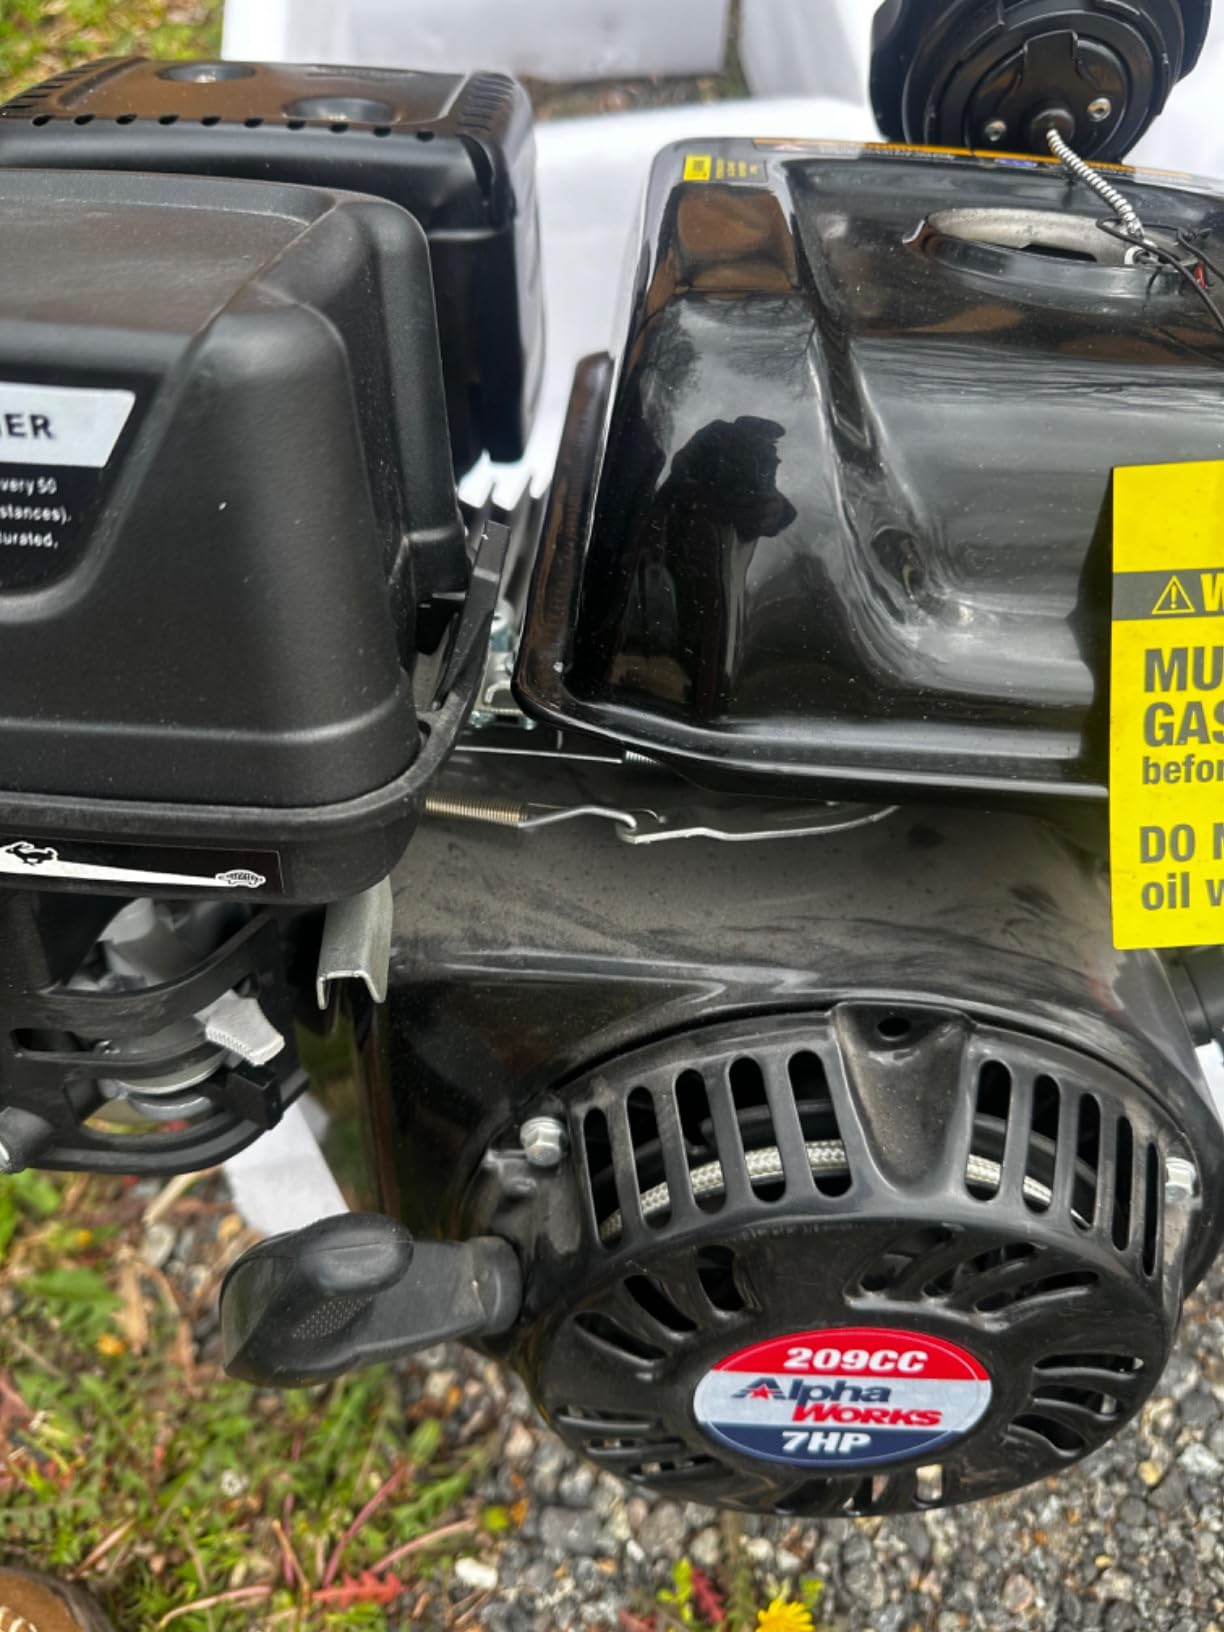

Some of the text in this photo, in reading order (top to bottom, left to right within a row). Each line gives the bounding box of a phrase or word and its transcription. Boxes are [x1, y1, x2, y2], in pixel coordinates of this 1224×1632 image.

[0, 412, 55, 439] ER
[1144, 646, 1224, 693] MU
[1139, 824, 1196, 864] DO
[1141, 872, 1190, 911] oil
[783, 1346, 928, 1373] 209CC
[731, 1376, 891, 1405] Alpha
[792, 1403, 943, 1427] WORKS
[782, 1430, 871, 1455] 7HP
